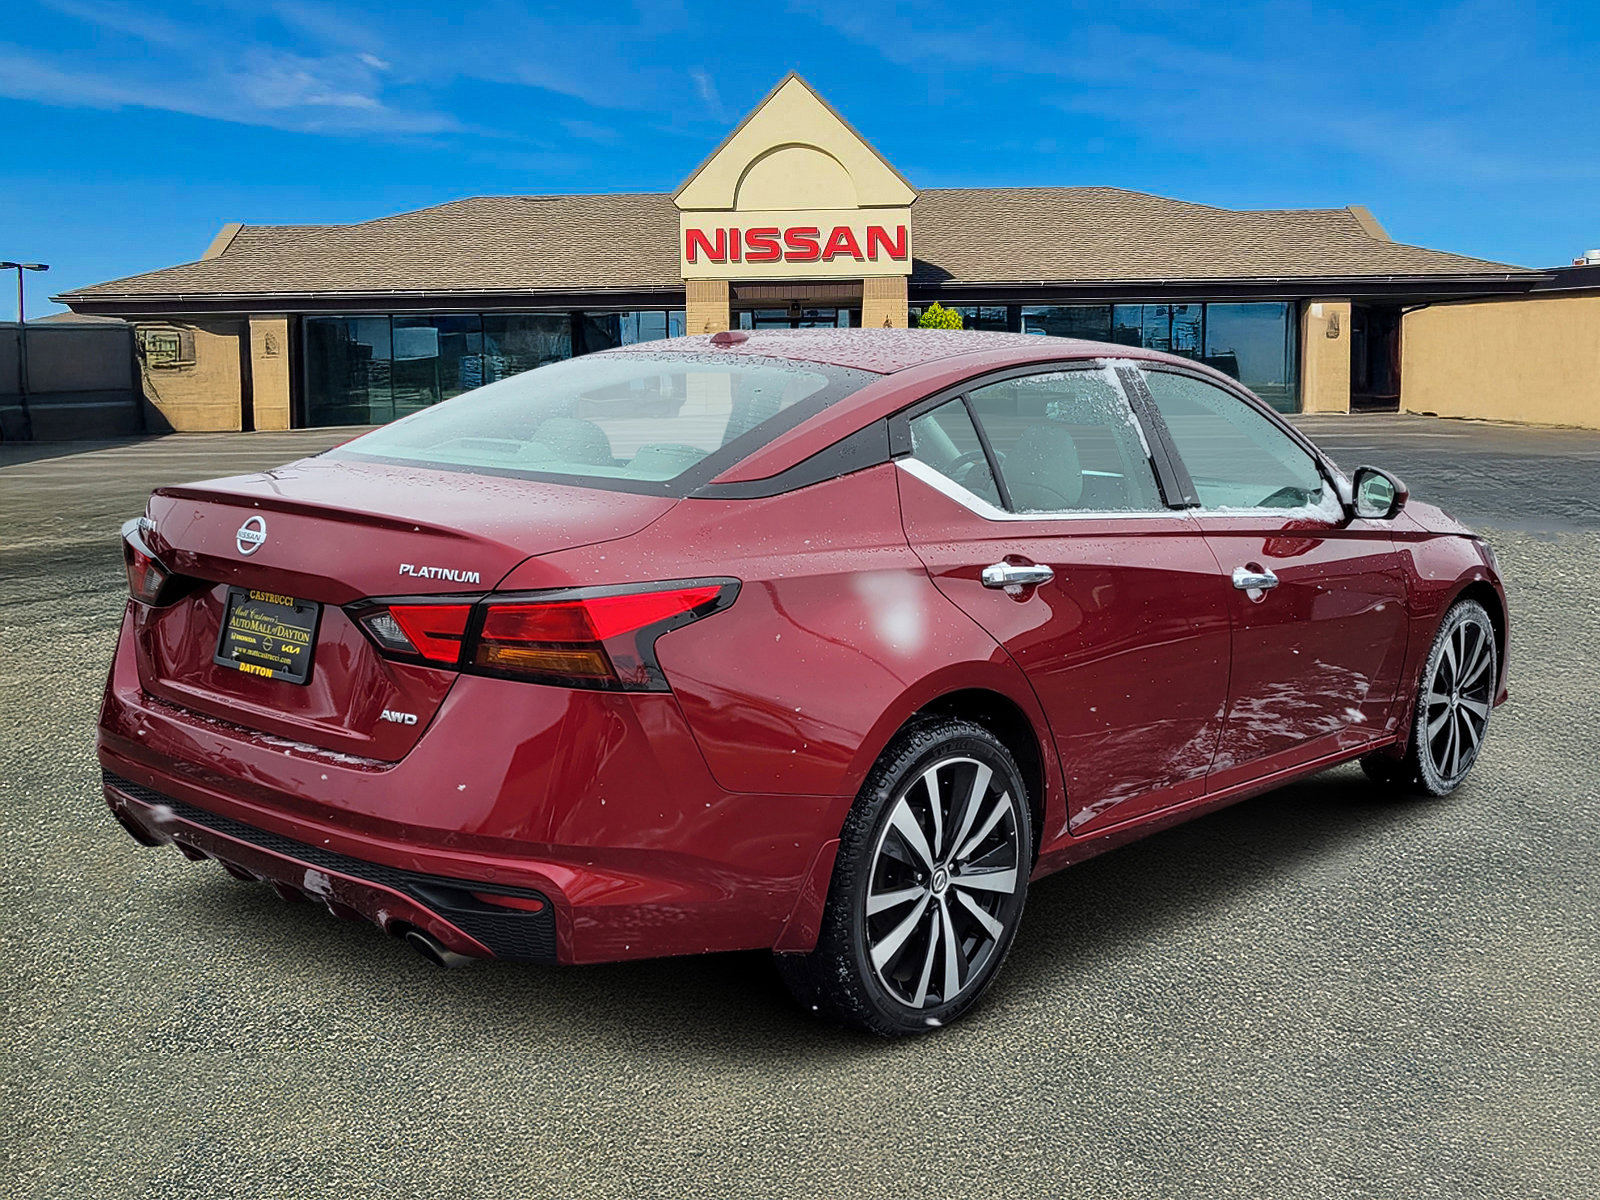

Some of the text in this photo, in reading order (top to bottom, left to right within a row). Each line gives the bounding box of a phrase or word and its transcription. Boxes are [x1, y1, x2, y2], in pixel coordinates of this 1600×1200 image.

[685, 225, 907, 264] NISSAN
[238, 531, 261, 541] NISSAN
[398, 563, 481, 585] PLATINUM
[249, 590, 294, 606] CASTRUCCI
[236, 634, 257, 643] HONDA
[239, 662, 273, 678] DAYTON
[379, 709, 418, 726] AWD
